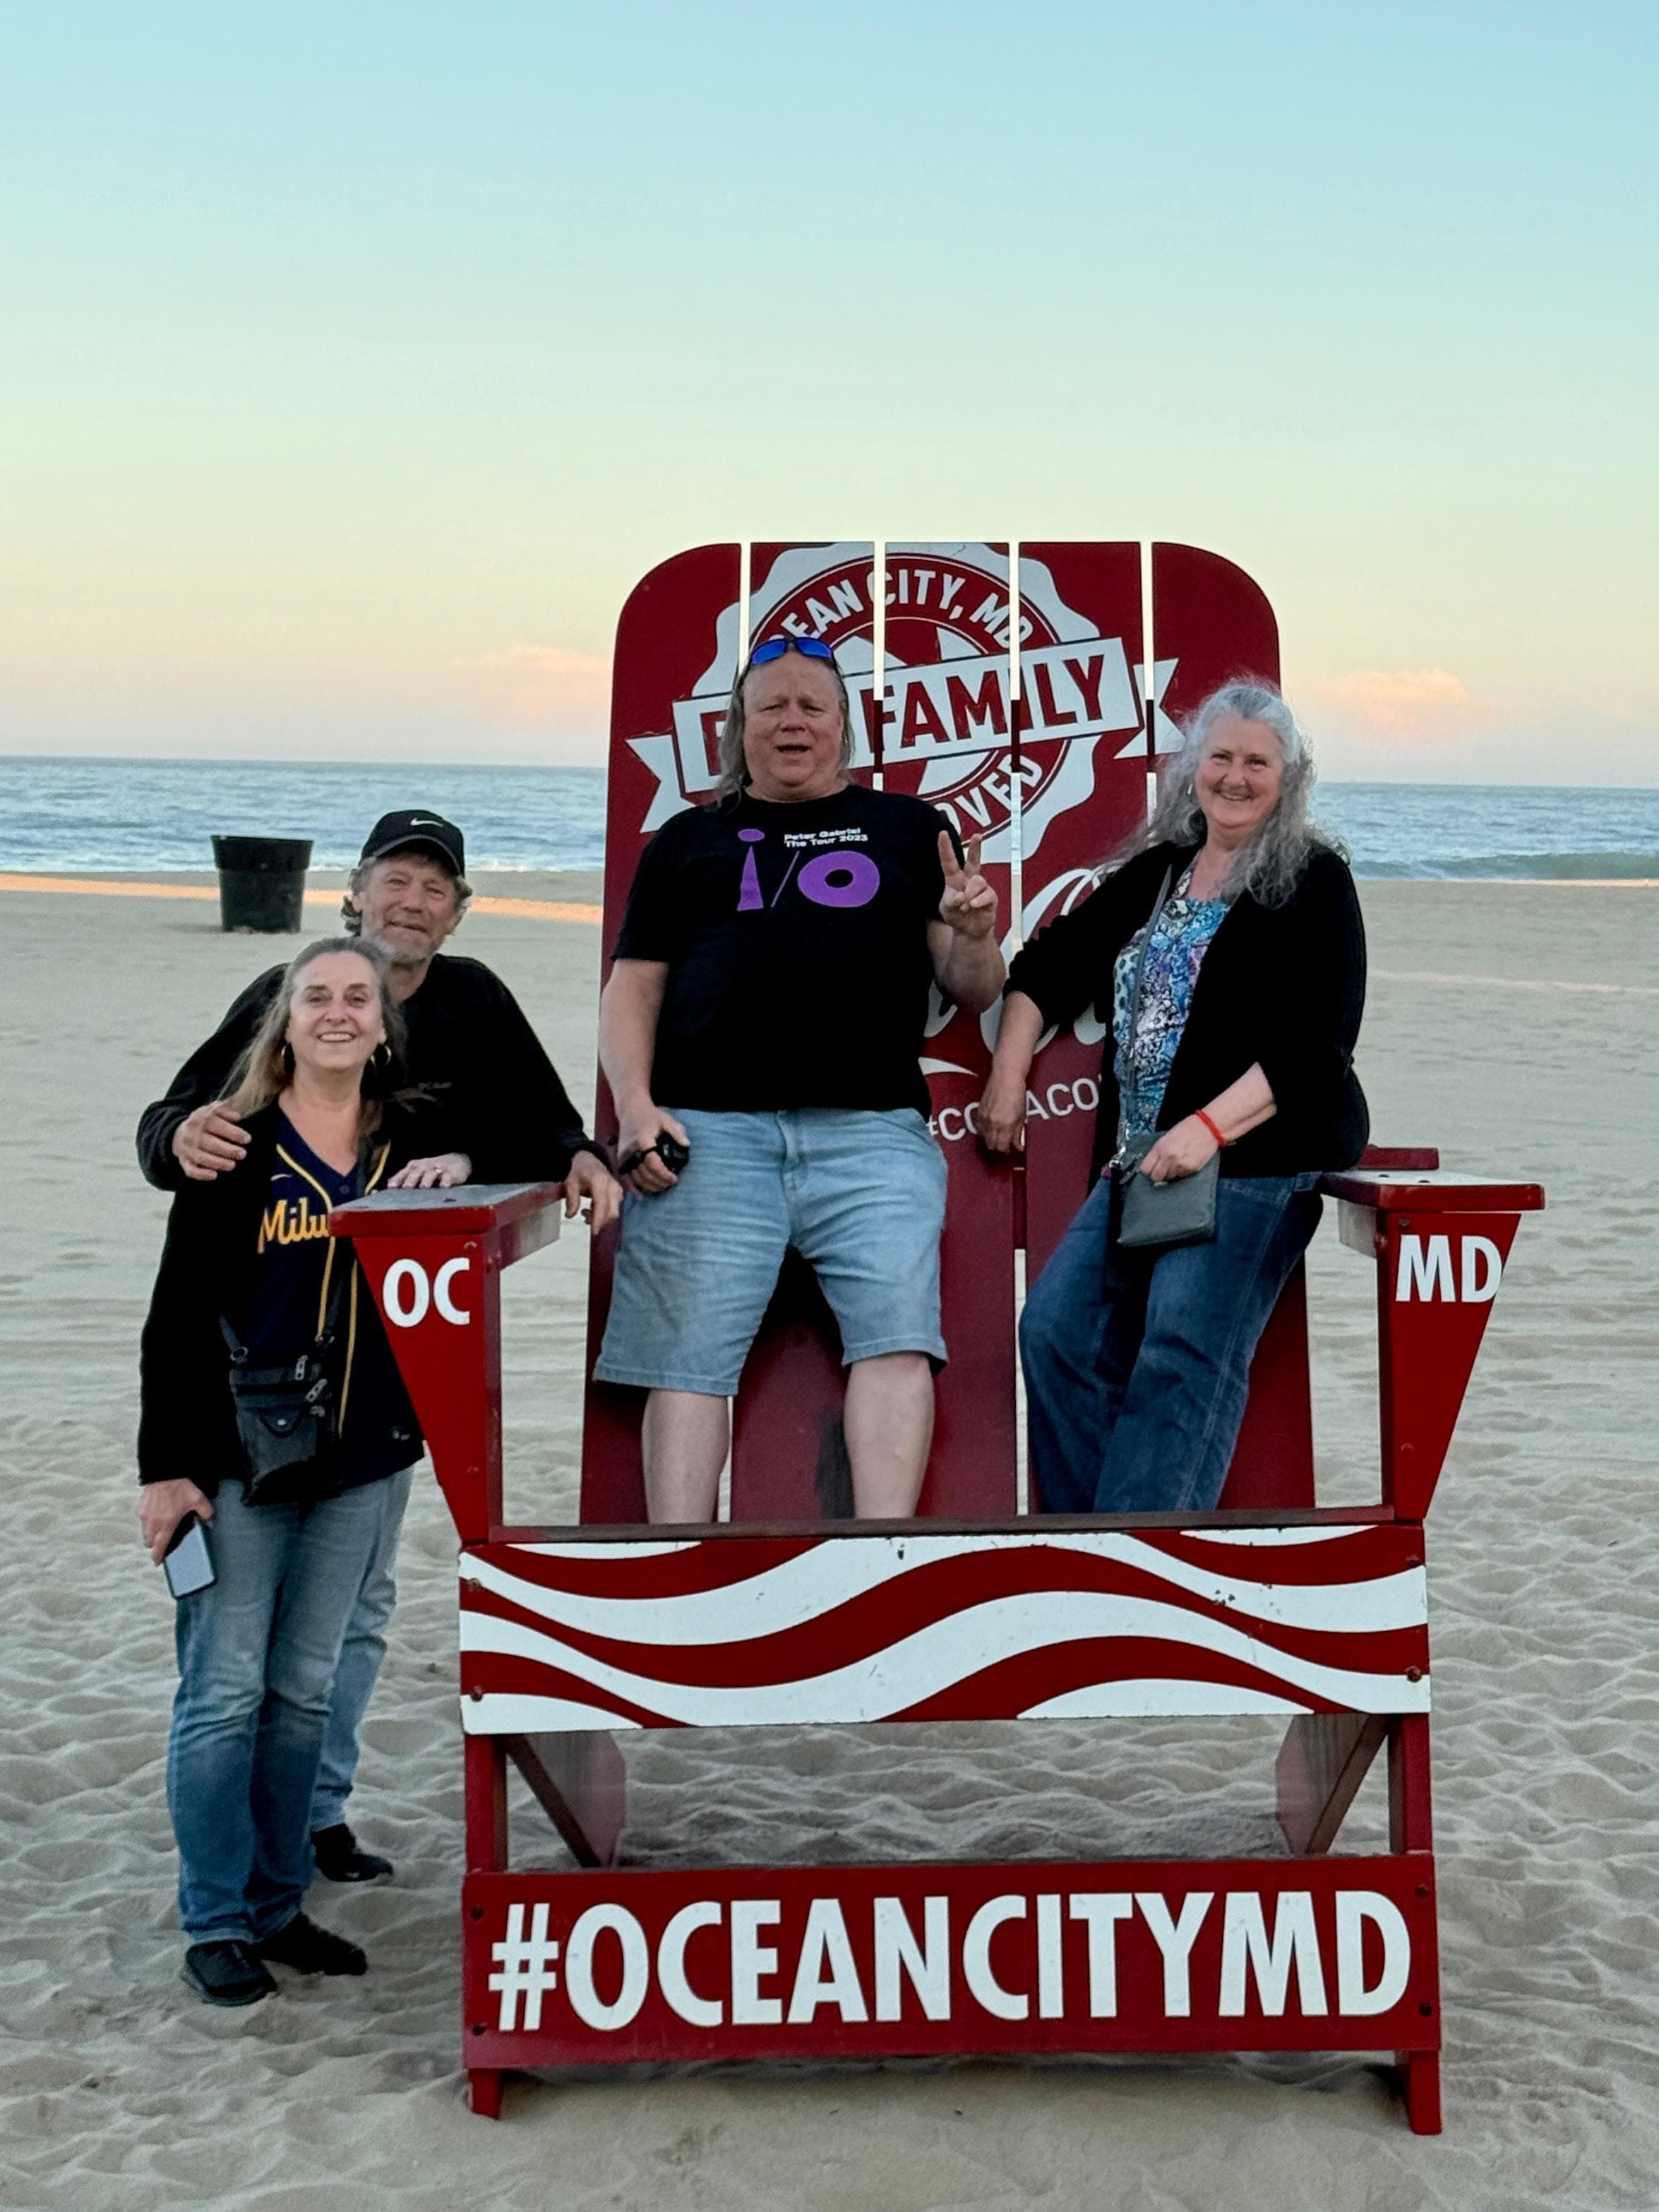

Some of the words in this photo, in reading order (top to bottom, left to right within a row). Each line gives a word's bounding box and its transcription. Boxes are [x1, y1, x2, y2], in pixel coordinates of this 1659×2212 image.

[769, 579, 864, 639] EAN
[866, 568, 966, 620] CITY,
[969, 592, 1034, 649] MD
[859, 654, 1106, 753] FAMILY
[784, 833, 816, 843] Peter
[819, 827, 861, 838] Gabriel
[810, 837, 836, 846] Tour
[382, 1256, 470, 1328] OC
[1395, 1234, 1502, 1303] MD
[489, 1890, 1413, 2032] #OCEANCITYMD
